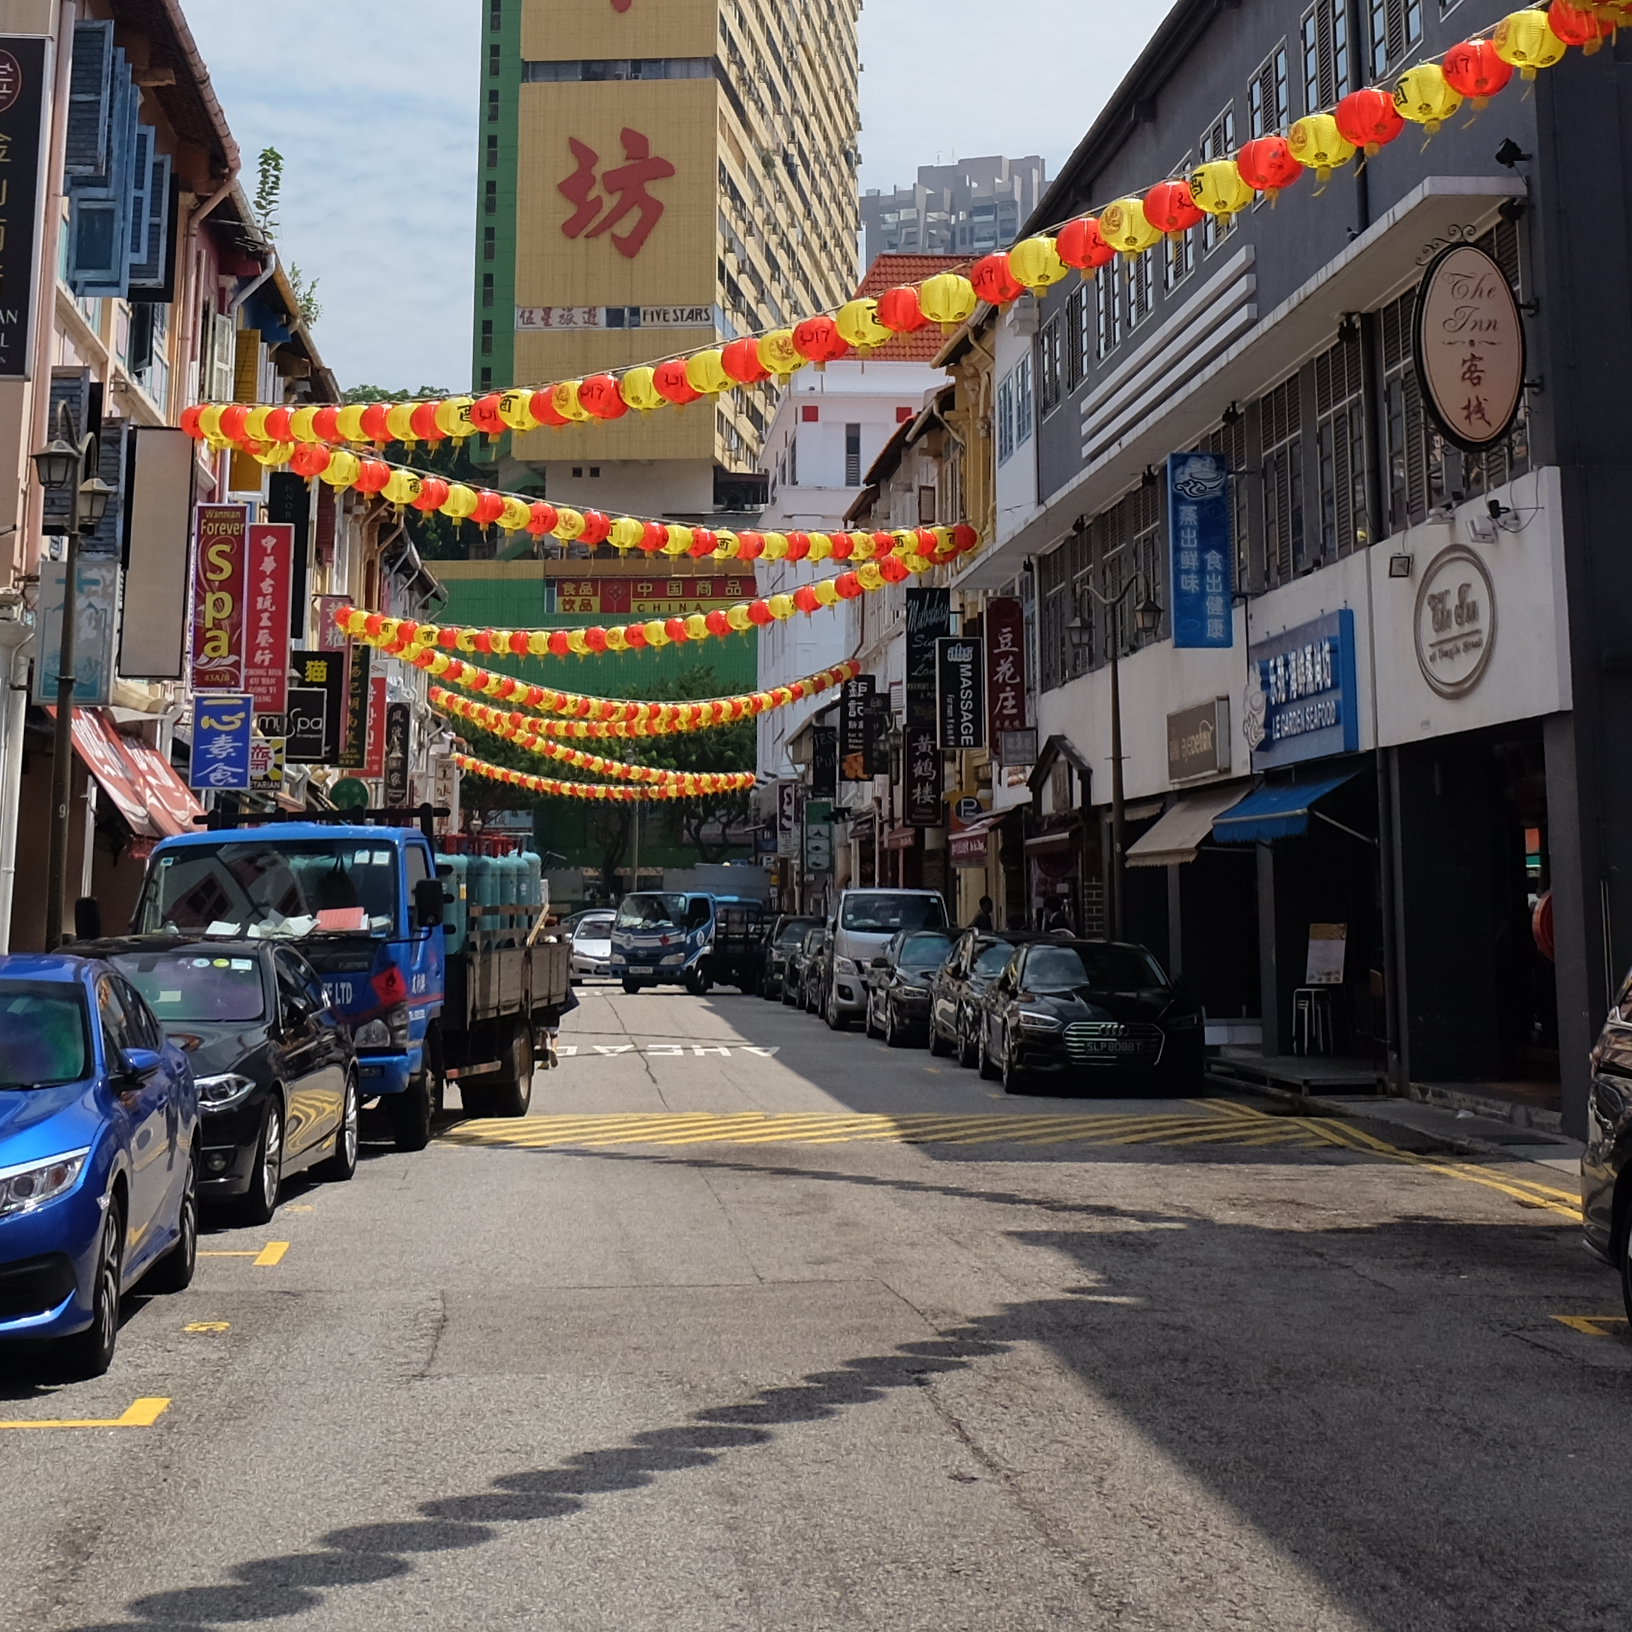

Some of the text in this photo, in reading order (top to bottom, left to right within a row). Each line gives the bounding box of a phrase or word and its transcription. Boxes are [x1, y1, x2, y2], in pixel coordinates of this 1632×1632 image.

[1440, 271, 1498, 301] The
[642, 307, 712, 324] FIVE STARS
[1442, 304, 1499, 334] Inn
[1459, 352, 1493, 429] 客栈
[200, 518, 245, 536] Forever
[203, 543, 234, 658] Spa
[561, 581, 594, 597] 食品
[637, 580, 743, 597] 中国商品
[561, 597, 593, 613] 饮品
[637, 602, 704, 613] CHINA
[304, 659, 328, 683] 猫
[992, 626, 1022, 716] 豆花庄
[959, 663, 974, 747] MASSAGE
[1272, 699, 1336, 741] LE GARDEN SEAFOOD
[194, 698, 246, 786] 一心素食
[911, 732, 937, 806] 黄鹤楼
[58, 803, 67, 819] 9
[335, 980, 353, 1005] LTD
